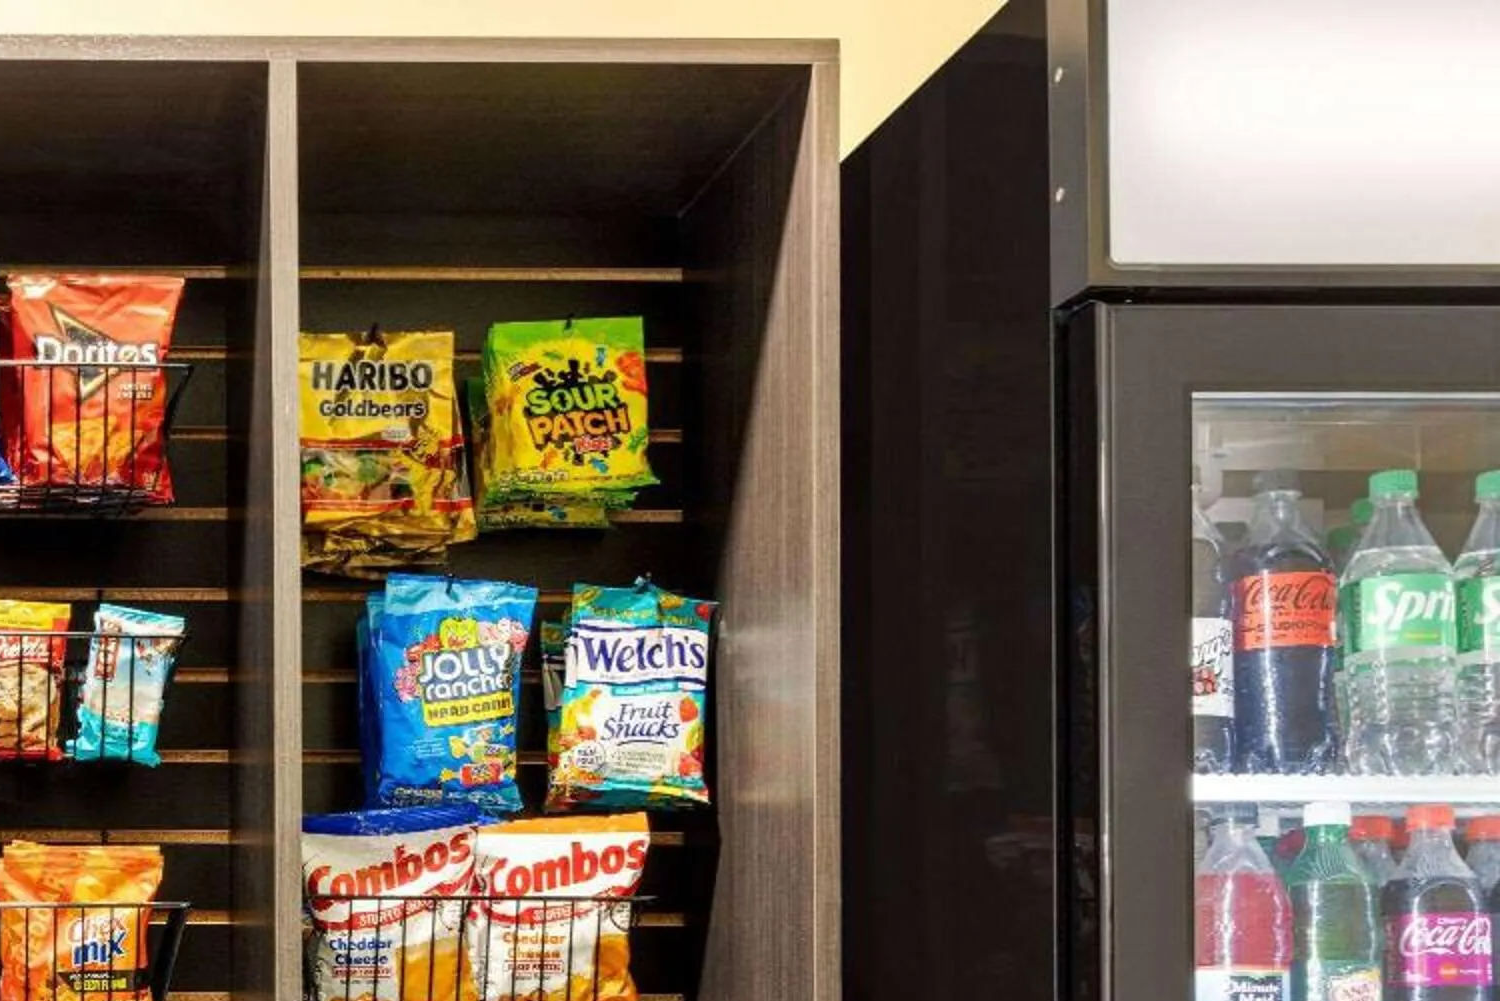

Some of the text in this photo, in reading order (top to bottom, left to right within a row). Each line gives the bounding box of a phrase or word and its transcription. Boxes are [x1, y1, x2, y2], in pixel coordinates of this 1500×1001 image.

[35, 336, 159, 366] Doritos
[312, 360, 434, 391] HARIBO
[319, 398, 427, 419] Goldbears
[524, 382, 619, 417] SOUR
[524, 405, 630, 448] PATCH
[419, 640, 510, 684] JOLLY
[581, 634, 705, 674] Welch's
[617, 701, 673, 723] Fruit
[601, 717, 682, 741] Snacks
[307, 831, 472, 912] Combos
[488, 840, 646, 903] Combos
[329, 938, 392, 951] Cheddar
[503, 931, 565, 944] Cheddar
[335, 953, 389, 965] Cheese
